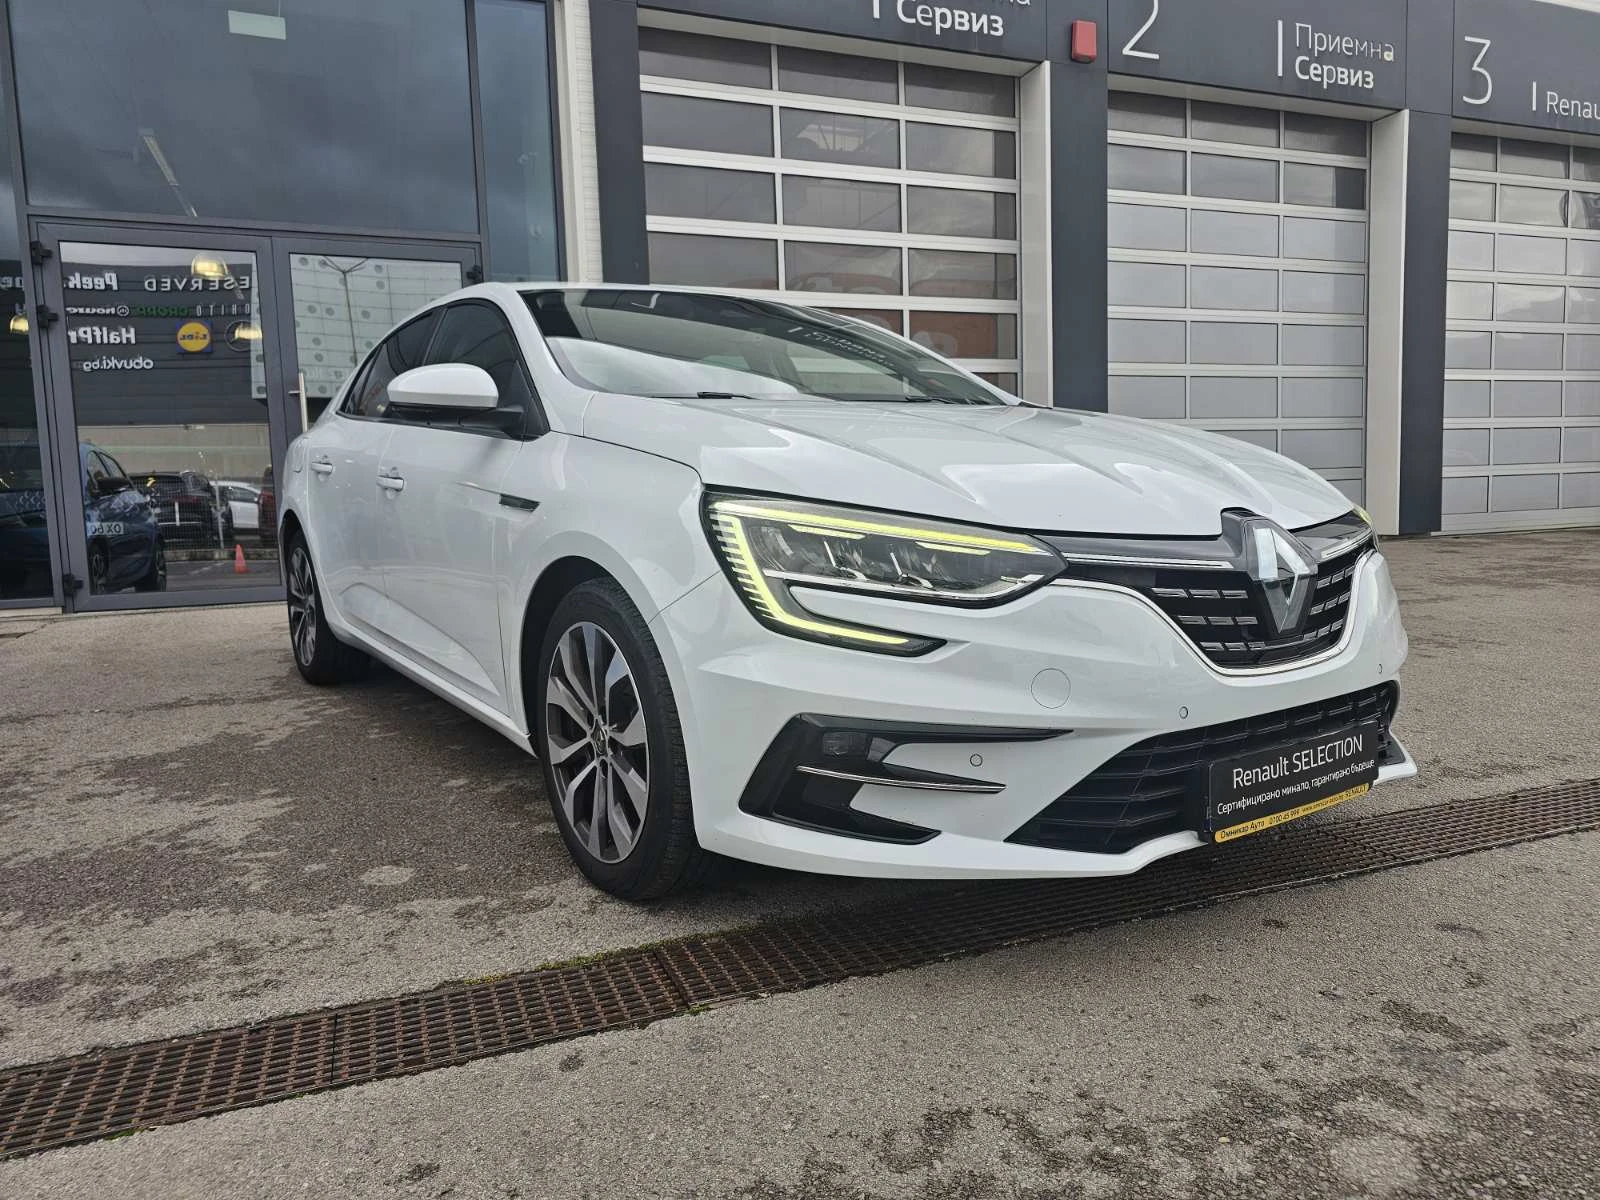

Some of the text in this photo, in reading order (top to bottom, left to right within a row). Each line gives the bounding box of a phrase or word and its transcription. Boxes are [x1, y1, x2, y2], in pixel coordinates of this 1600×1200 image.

[897, 0, 1004, 36] Сервиз
[1122, 0, 1160, 60] 2
[1295, 22, 1395, 62] Приемна
[1295, 55, 1374, 89] Сервиз
[1462, 35, 1493, 105] 3
[1232, 734, 1363, 789] Renault SELECTION
[1217, 788, 1281, 815] Сертифицирано
[1281, 781, 1311, 797] минало,
